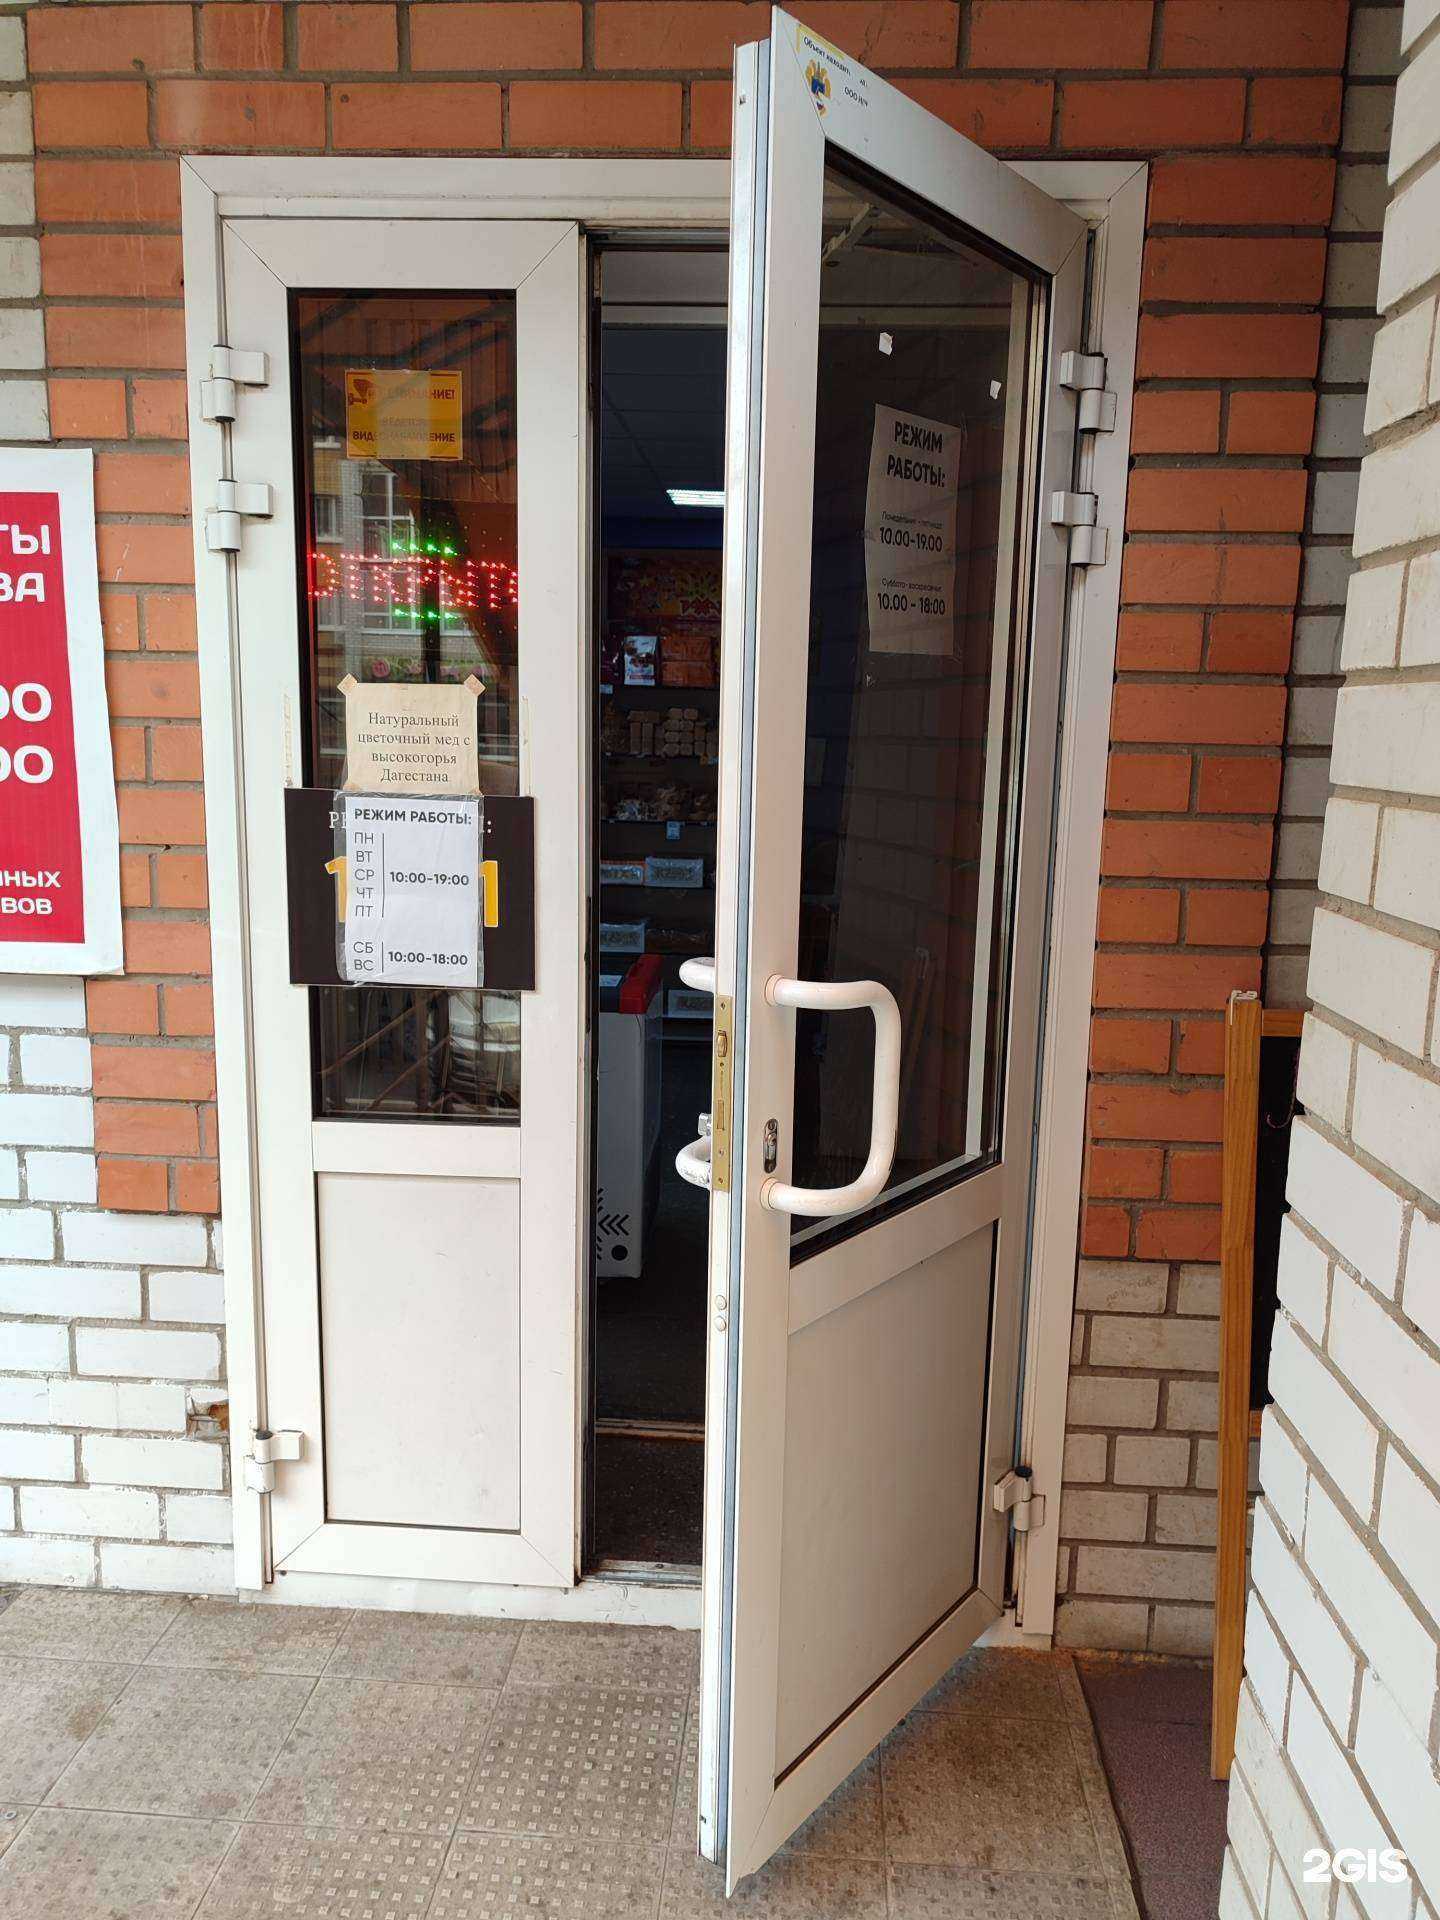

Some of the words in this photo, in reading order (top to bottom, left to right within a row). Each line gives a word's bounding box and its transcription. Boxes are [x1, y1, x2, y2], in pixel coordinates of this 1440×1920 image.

[894, 421, 943, 453] РЕЖИМ
[887, 454, 945, 488] РАБОТЫ:
[879, 526, 943, 552] 10.00-19.00
[877, 592, 908, 612] 10.00
[919, 597, 946, 616] 18:00
[368, 712, 459, 728] Натуральный
[358, 732, 430, 745] цветочный
[435, 738, 460, 746] мед
[463, 738, 471, 746] с
[372, 752, 457, 766] высокогорья
[380, 768, 449, 783] Дагестана
[354, 808, 406, 822] РЕЖИМ
[410, 810, 472, 825] РАБОТЫ:
[353, 832, 374, 845] ПН
[356, 850, 372, 863] ВТ
[354, 869, 375, 881] СР
[389, 871, 470, 886] 10:00-19:00
[356, 887, 374, 899] ЧТ
[355, 905, 374, 917] ПТ
[353, 941, 374, 954] СБ
[354, 959, 374, 972] ВС
[388, 951, 468, 966] 10:00-18:00
